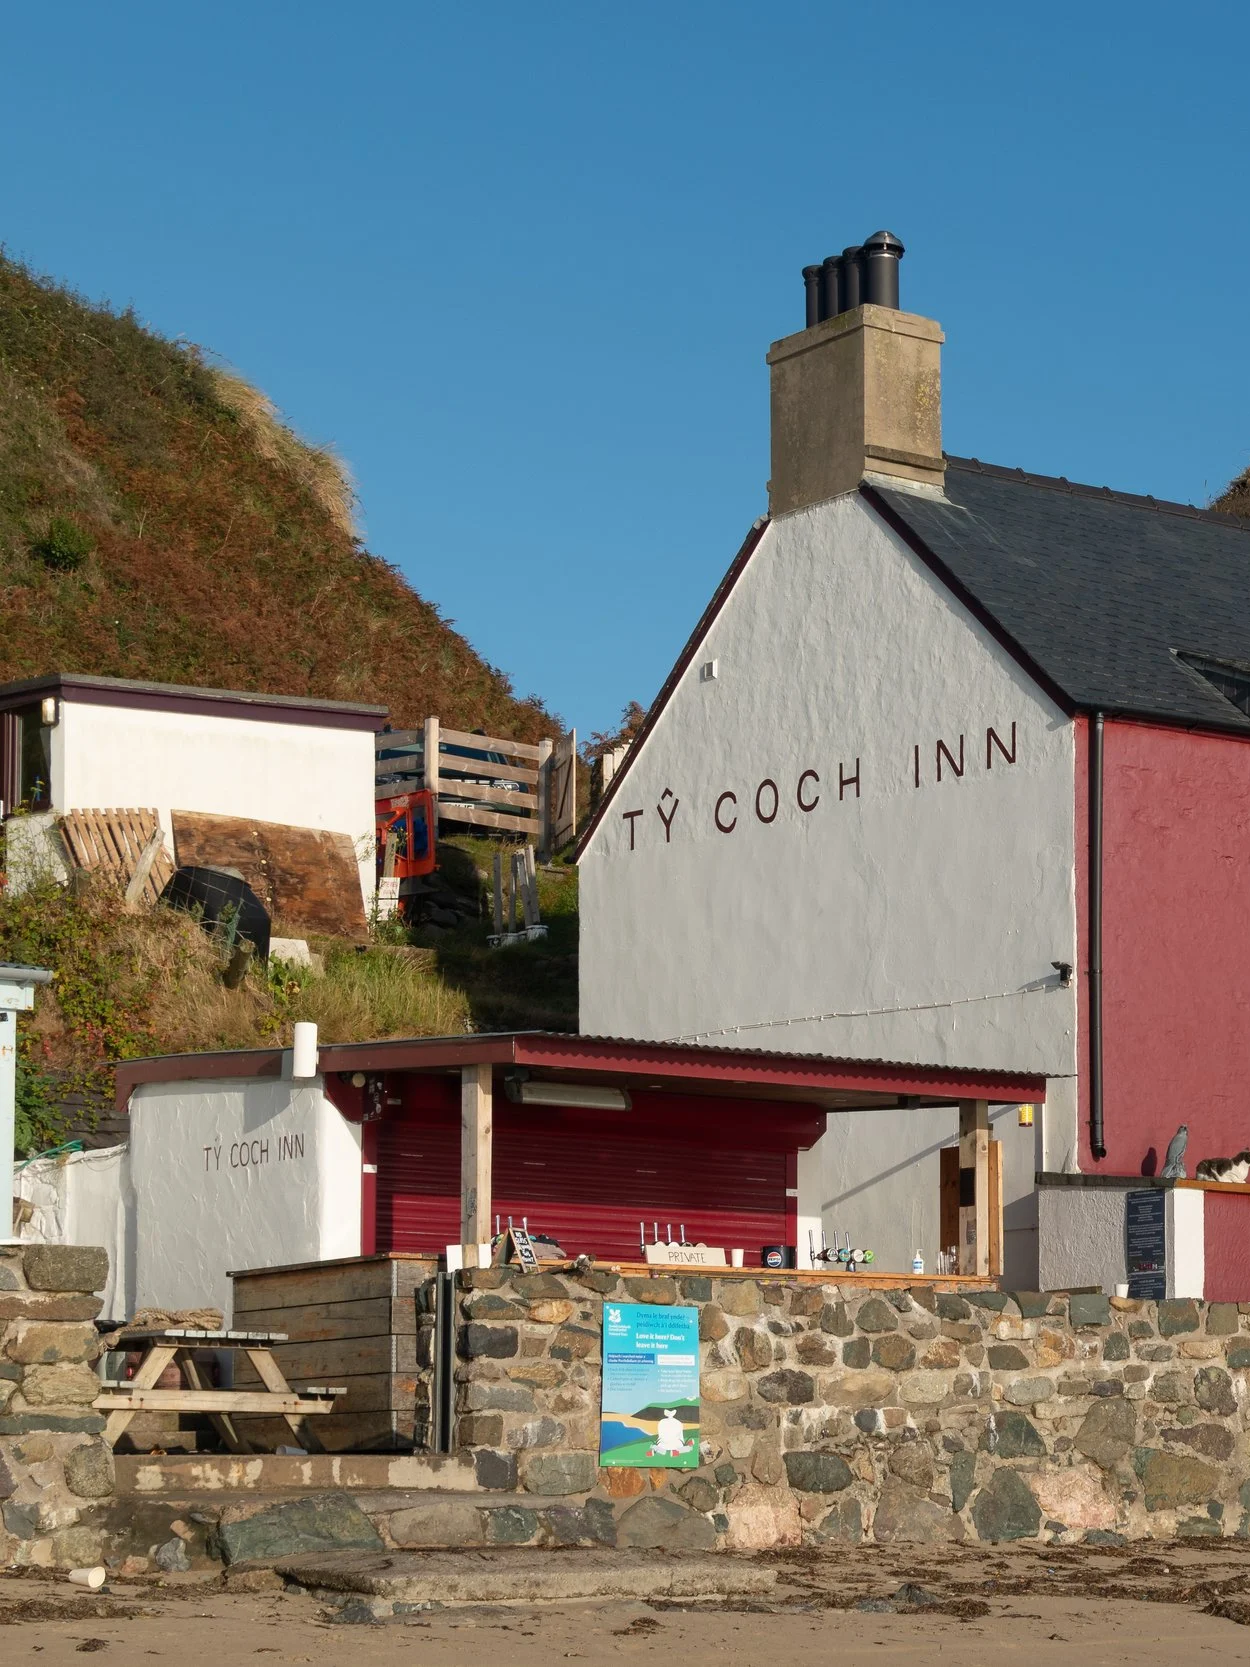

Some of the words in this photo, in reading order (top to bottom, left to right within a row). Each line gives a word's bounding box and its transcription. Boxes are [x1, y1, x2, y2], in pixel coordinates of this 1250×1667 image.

[714, 757, 861, 834] COCH
[914, 721, 1017, 789] INN
[230, 1139, 269, 1168] COCH
[278, 1133, 305, 1161] INN
[668, 1252, 706, 1264] PRIVATE
